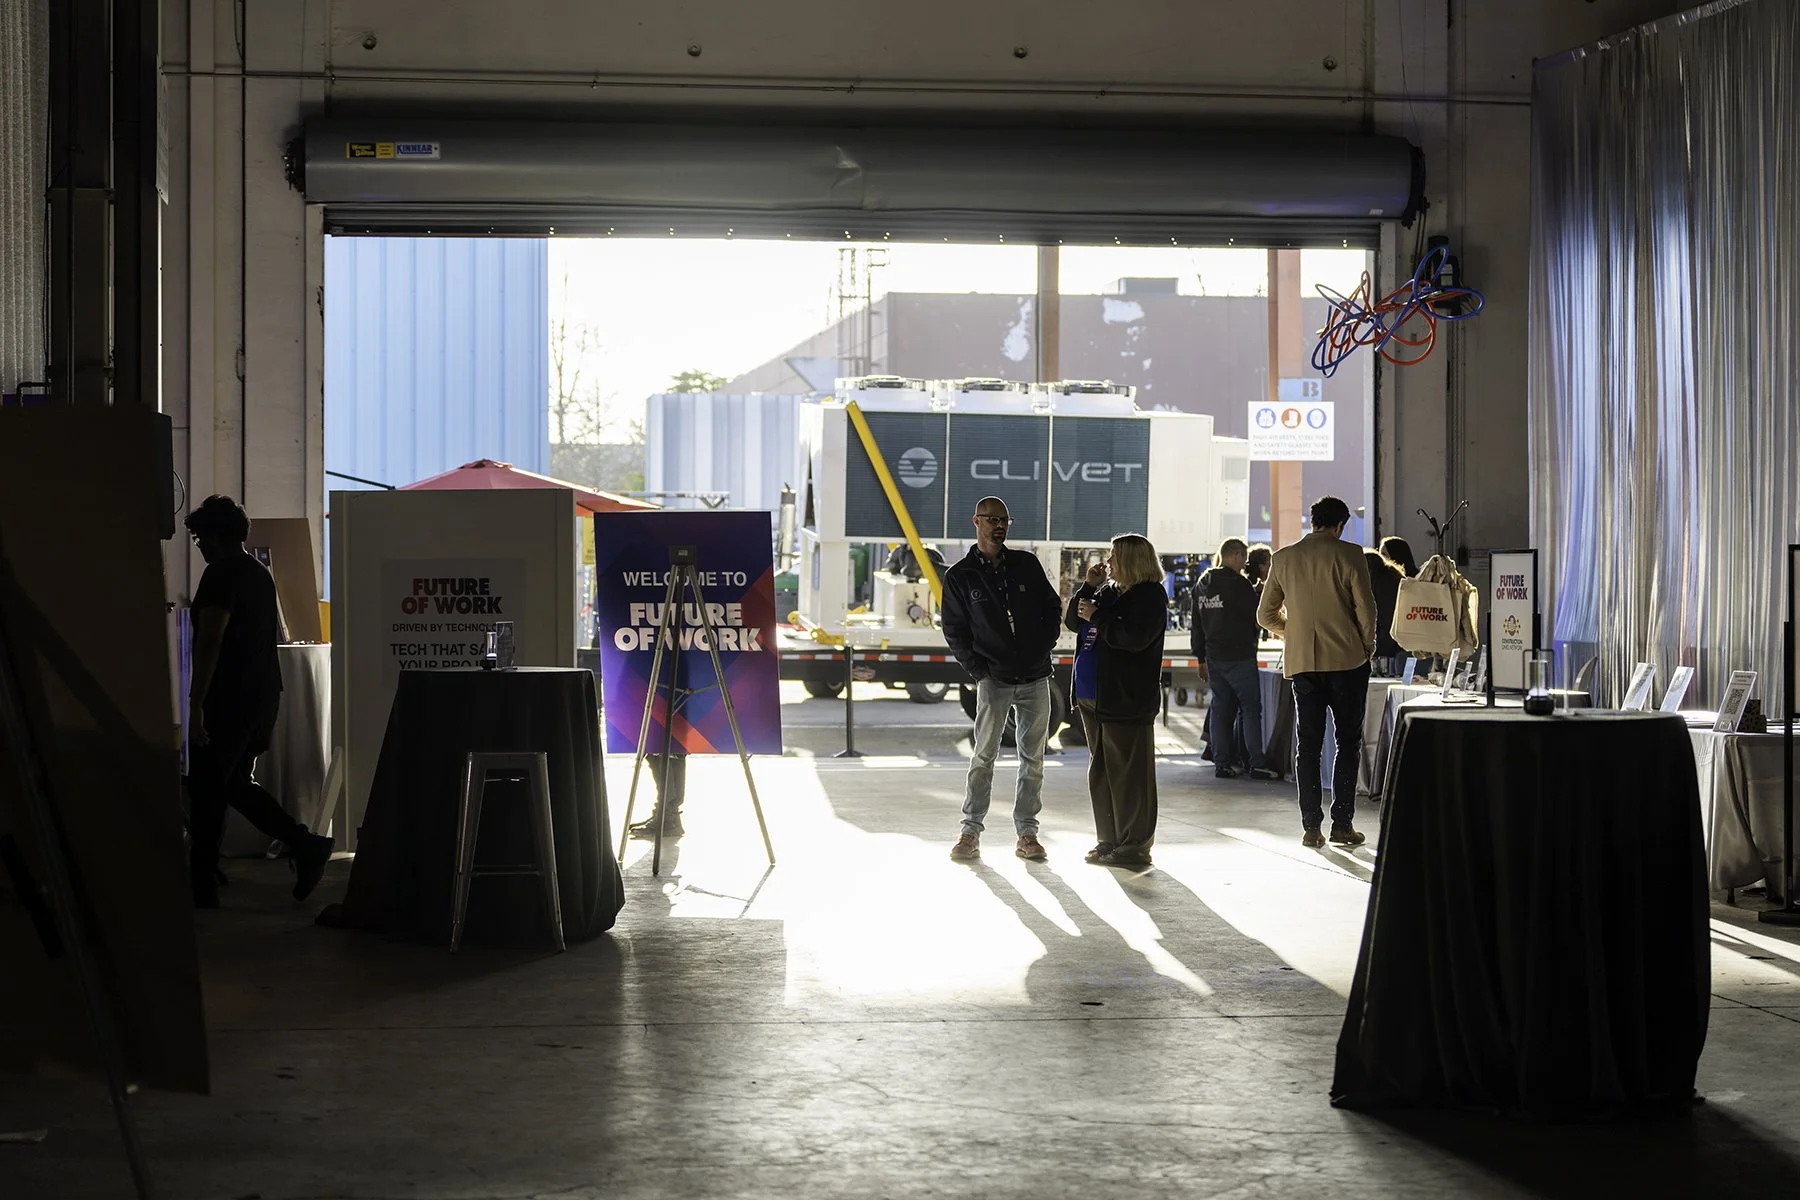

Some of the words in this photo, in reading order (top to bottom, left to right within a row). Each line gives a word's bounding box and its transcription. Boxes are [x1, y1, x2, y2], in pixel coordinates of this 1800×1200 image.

[722, 571, 747, 587] TO
[1499, 575, 1525, 587] FUTURE
[412, 577, 490, 596] FUTURE
[1496, 587, 1505, 600] OF
[1507, 588, 1528, 600] WORK
[401, 597, 429, 615] OF
[434, 597, 503, 615] WORK
[1204, 601, 1223, 609] WORK
[1411, 606, 1444, 615] FUTURE
[1406, 613, 1419, 621] OF
[1420, 613, 1448, 622] WORK
[392, 623, 428, 632] DRIVEN
[430, 623, 442, 632] BY
[446, 623, 497, 632] TECHNOLO
[614, 627, 655, 652] OF
[656, 627, 763, 652] WORK
[390, 643, 428, 656] TECH
[431, 643, 465, 656] THAT
[398, 660, 437, 670] YOUR
